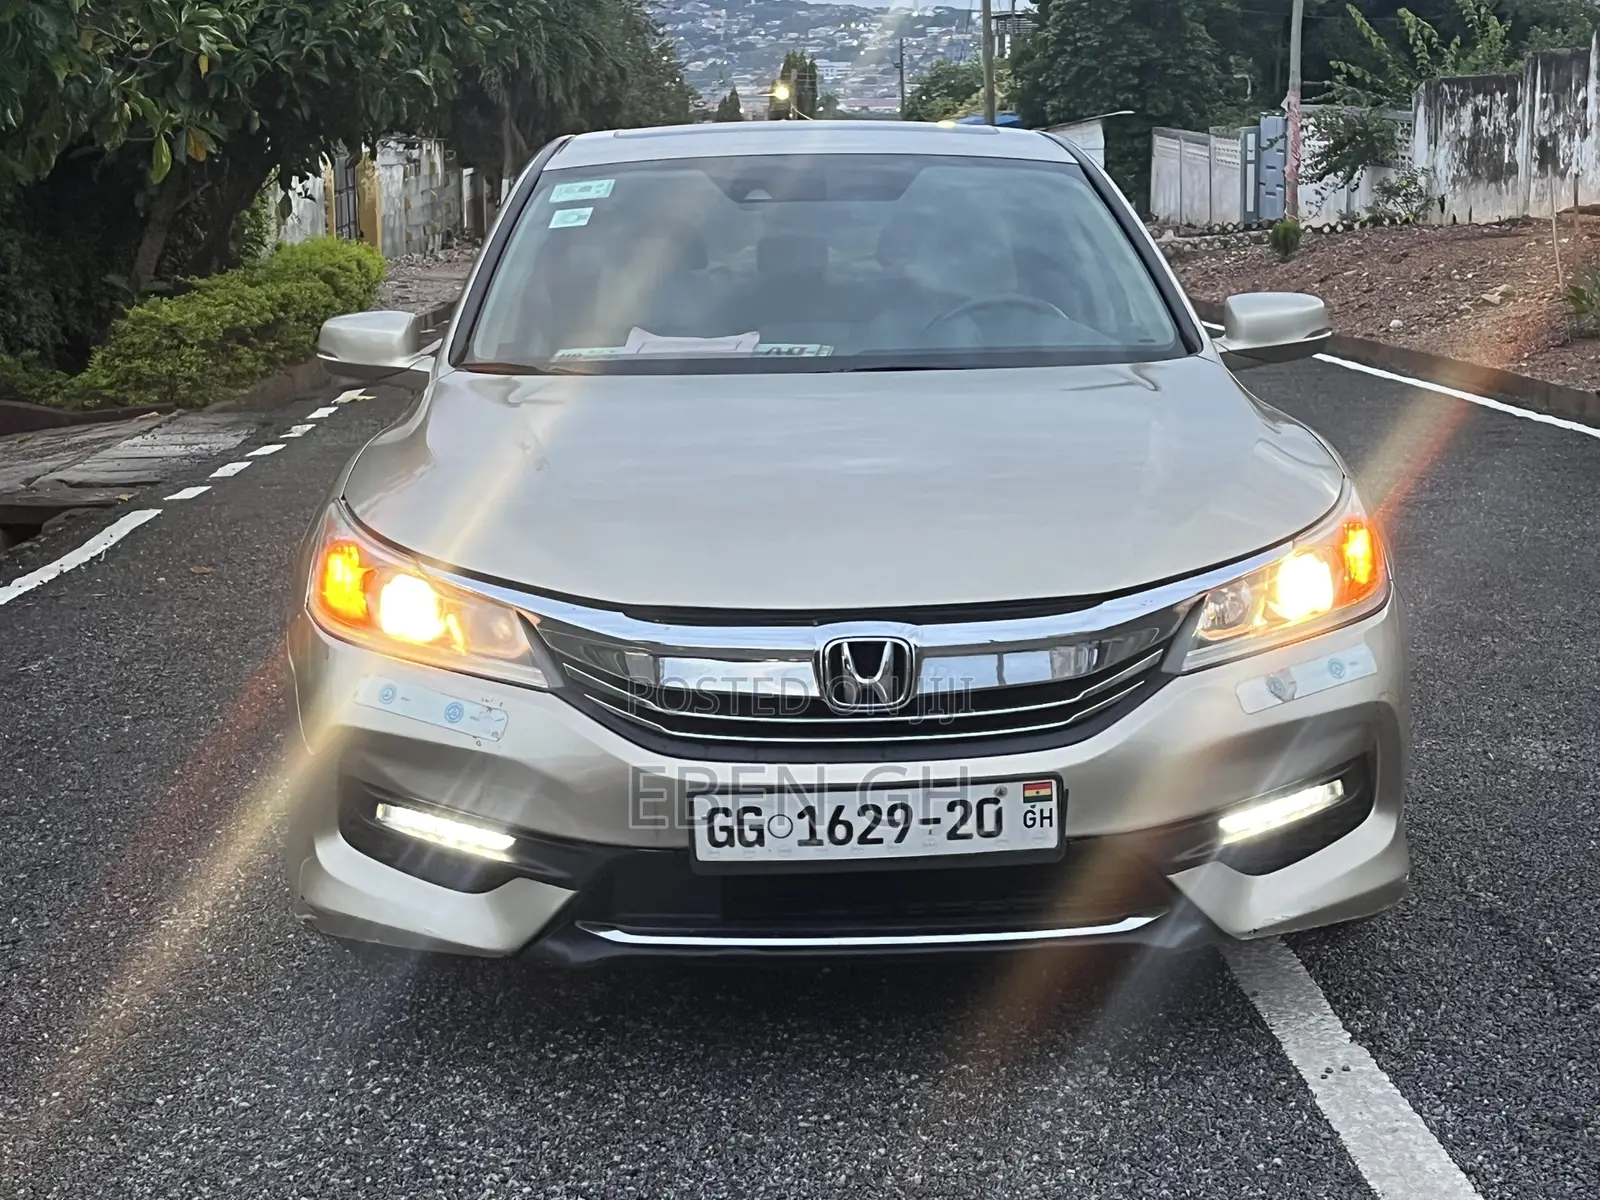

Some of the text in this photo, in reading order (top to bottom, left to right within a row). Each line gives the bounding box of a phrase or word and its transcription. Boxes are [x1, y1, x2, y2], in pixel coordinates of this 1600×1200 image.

[706, 796, 1004, 849] GG 1629-20
[1022, 806, 1054, 830] GH
